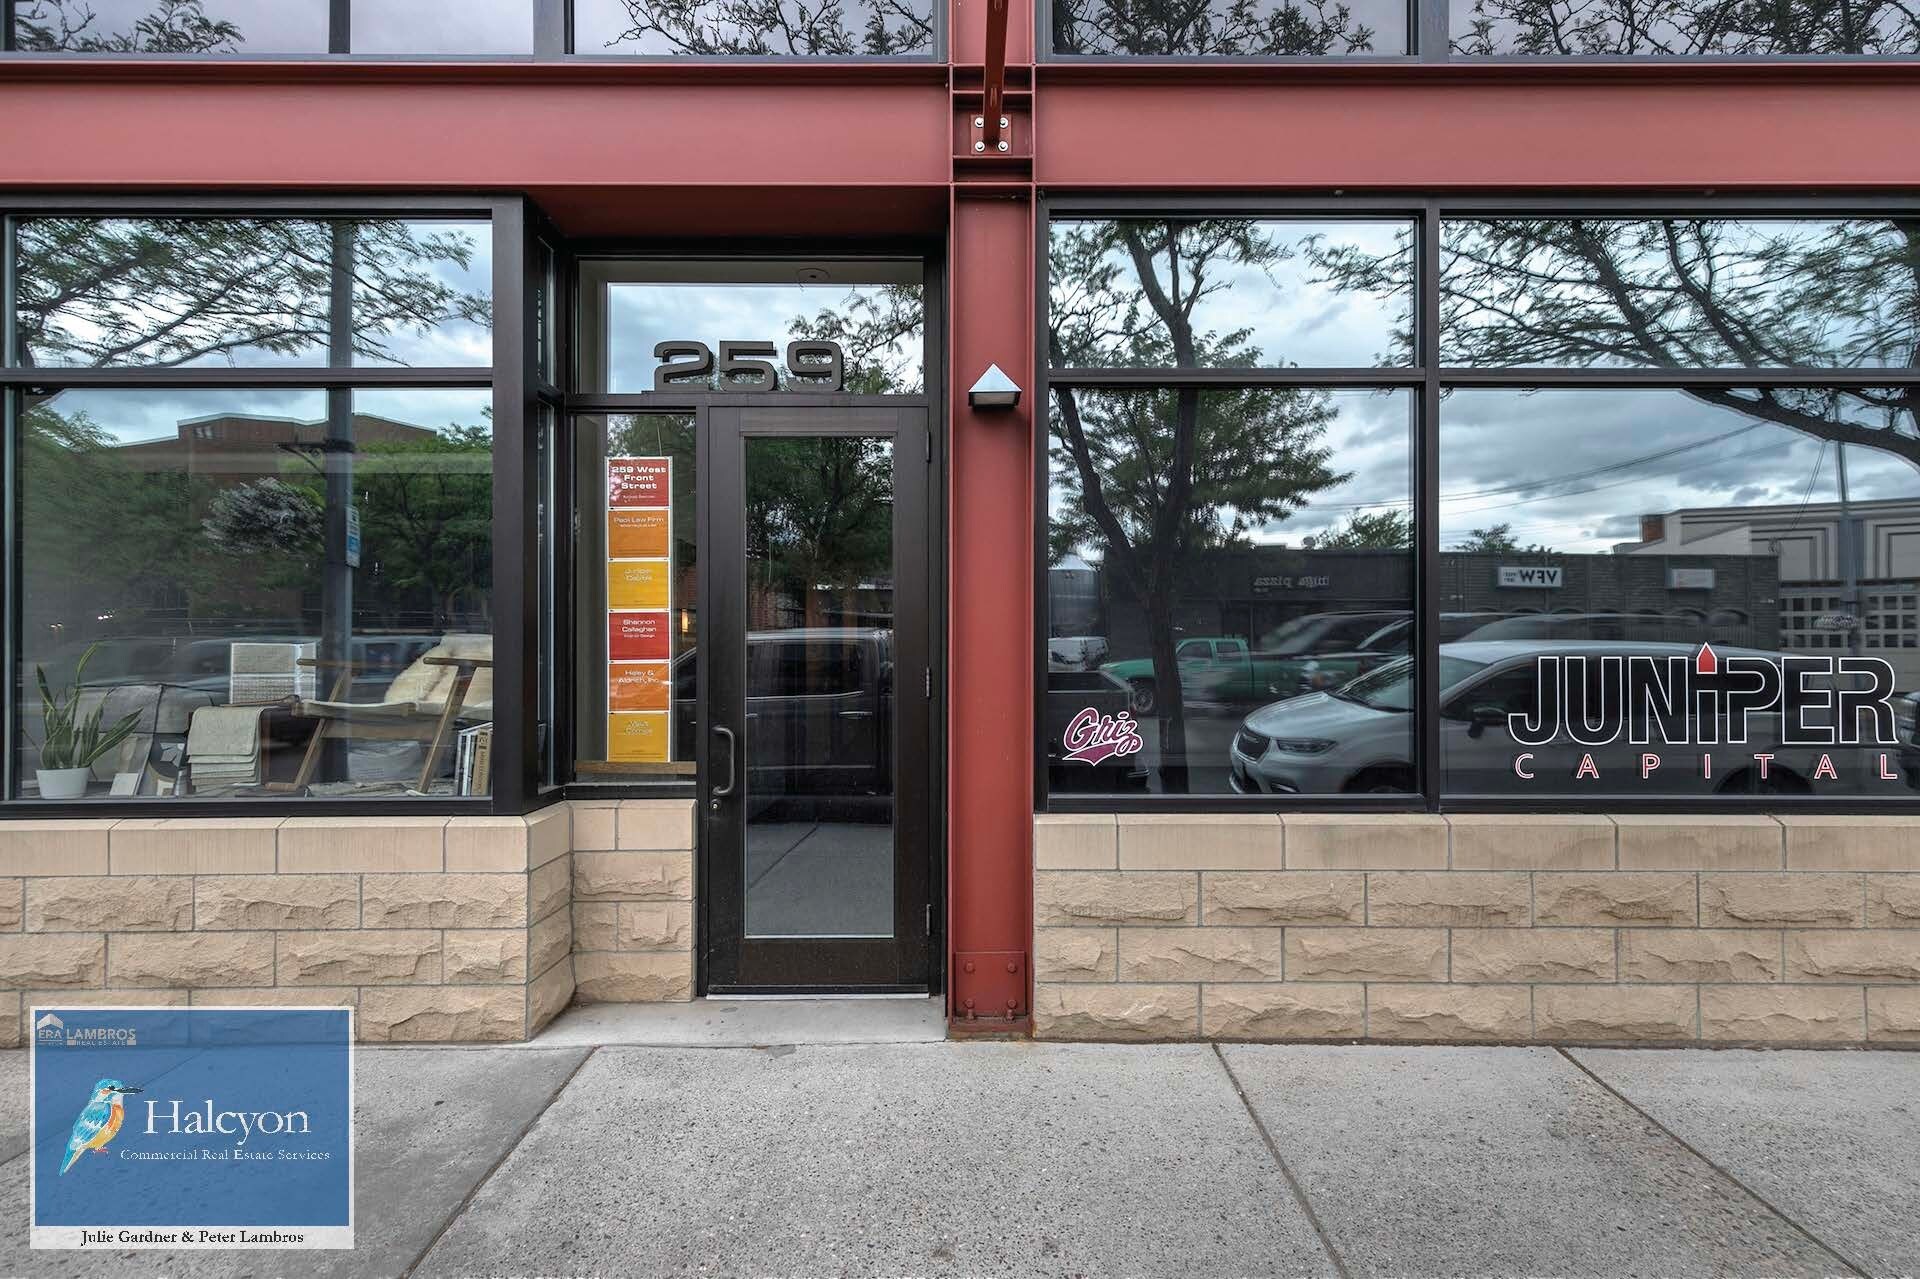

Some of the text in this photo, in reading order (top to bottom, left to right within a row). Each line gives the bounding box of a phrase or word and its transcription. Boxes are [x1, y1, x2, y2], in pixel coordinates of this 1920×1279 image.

[654, 340, 844, 392] 259
[1063, 707, 1143, 758] Griz
[1515, 754, 1898, 780] CAPITAL
